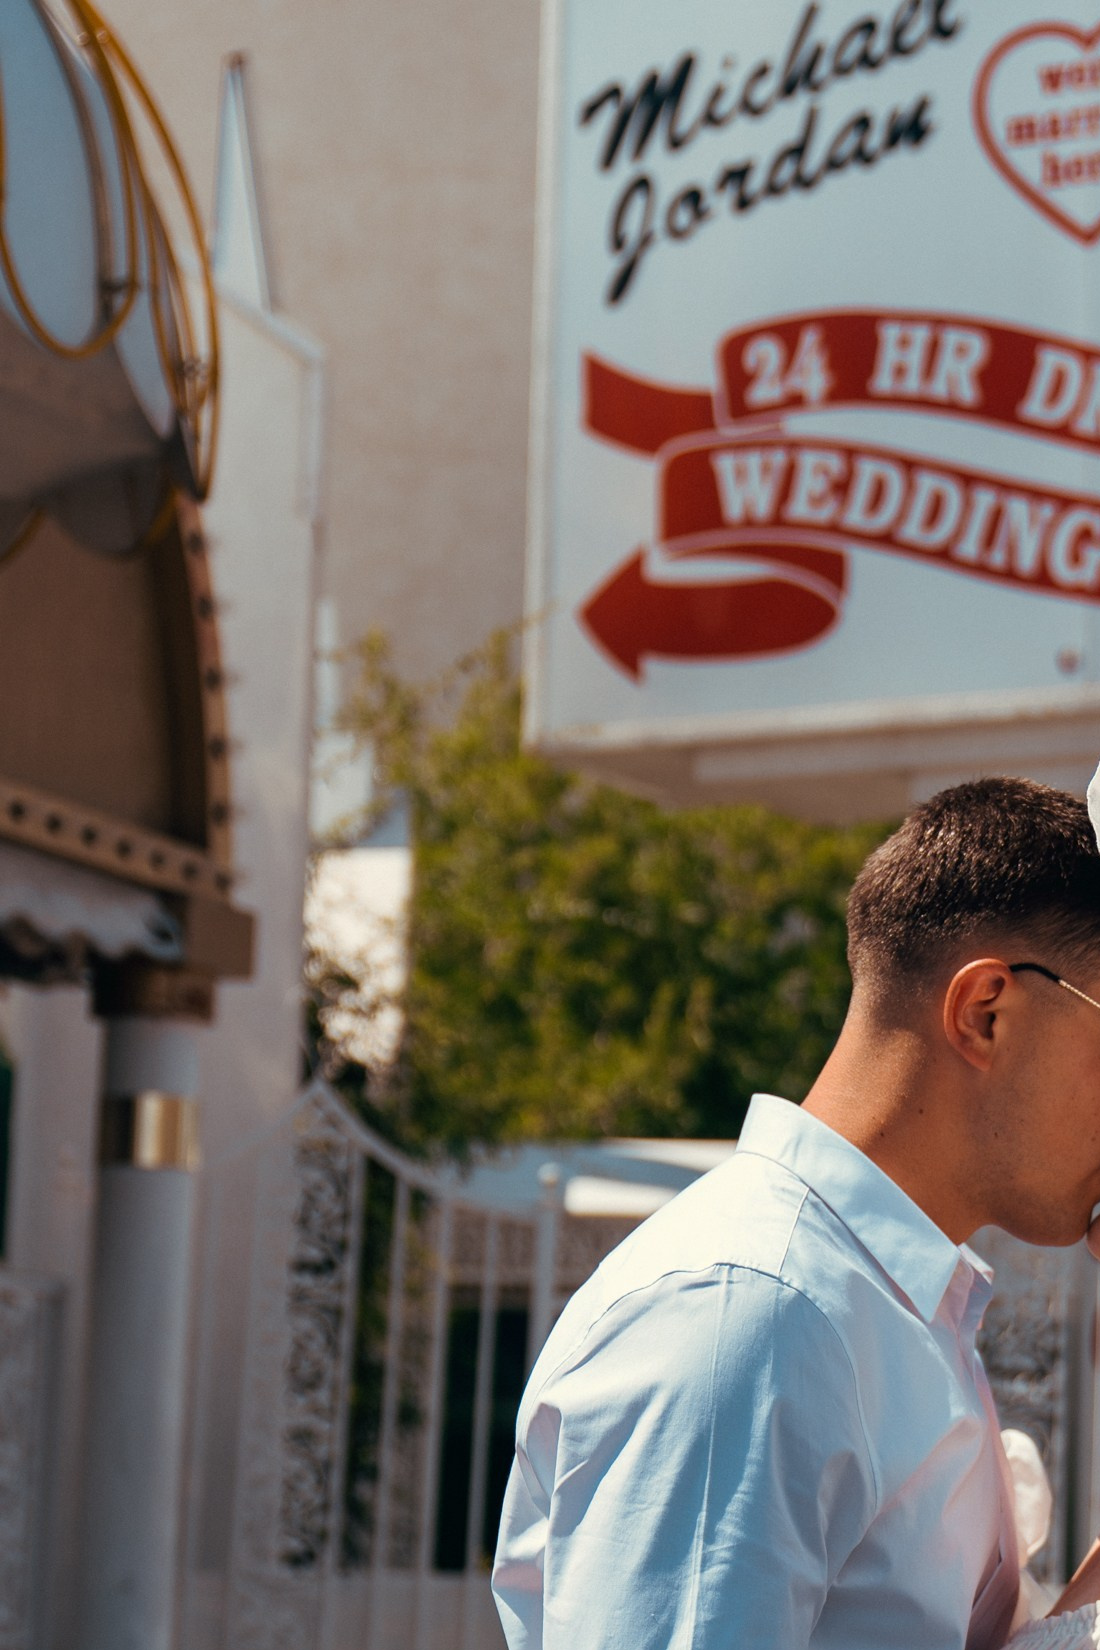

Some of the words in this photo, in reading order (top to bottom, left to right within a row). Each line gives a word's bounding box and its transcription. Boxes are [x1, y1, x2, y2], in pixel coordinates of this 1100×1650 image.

[608, 94, 933, 307] Jordan
[742, 327, 832, 406] 24
[868, 321, 988, 402] HR
